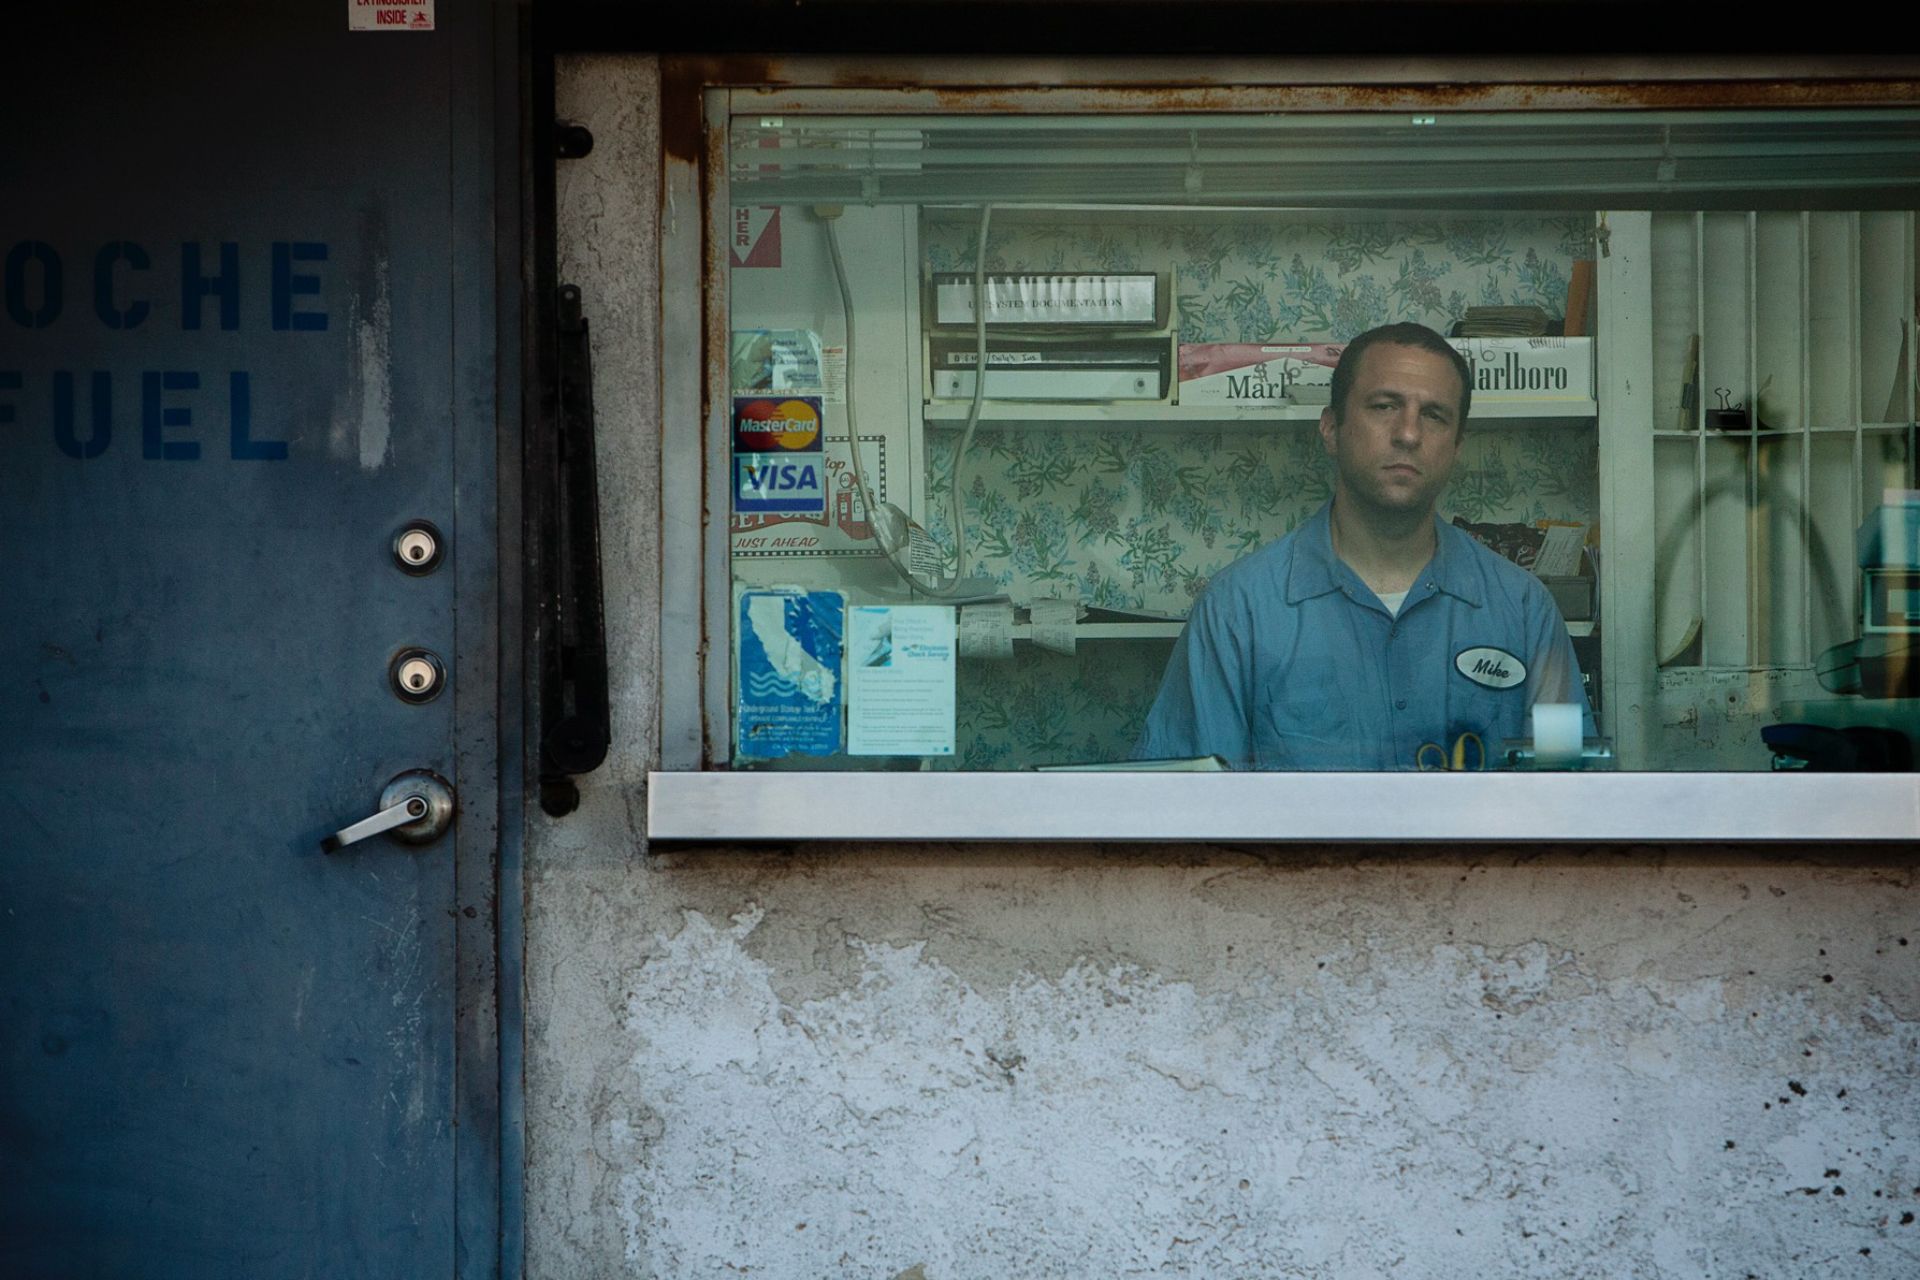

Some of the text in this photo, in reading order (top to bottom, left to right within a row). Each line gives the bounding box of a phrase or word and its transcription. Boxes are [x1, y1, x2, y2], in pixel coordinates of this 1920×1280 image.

[377, 10, 407, 24] INSIDE
[5, 240, 328, 331] OCHE
[1470, 352, 1568, 391] arlboro
[740, 418, 817, 433] MasterCard
[743, 464, 818, 490] VISA
[825, 456, 846, 478] top
[736, 537, 819, 549] JUST AHEAD
[1472, 658, 1511, 679] Mike
